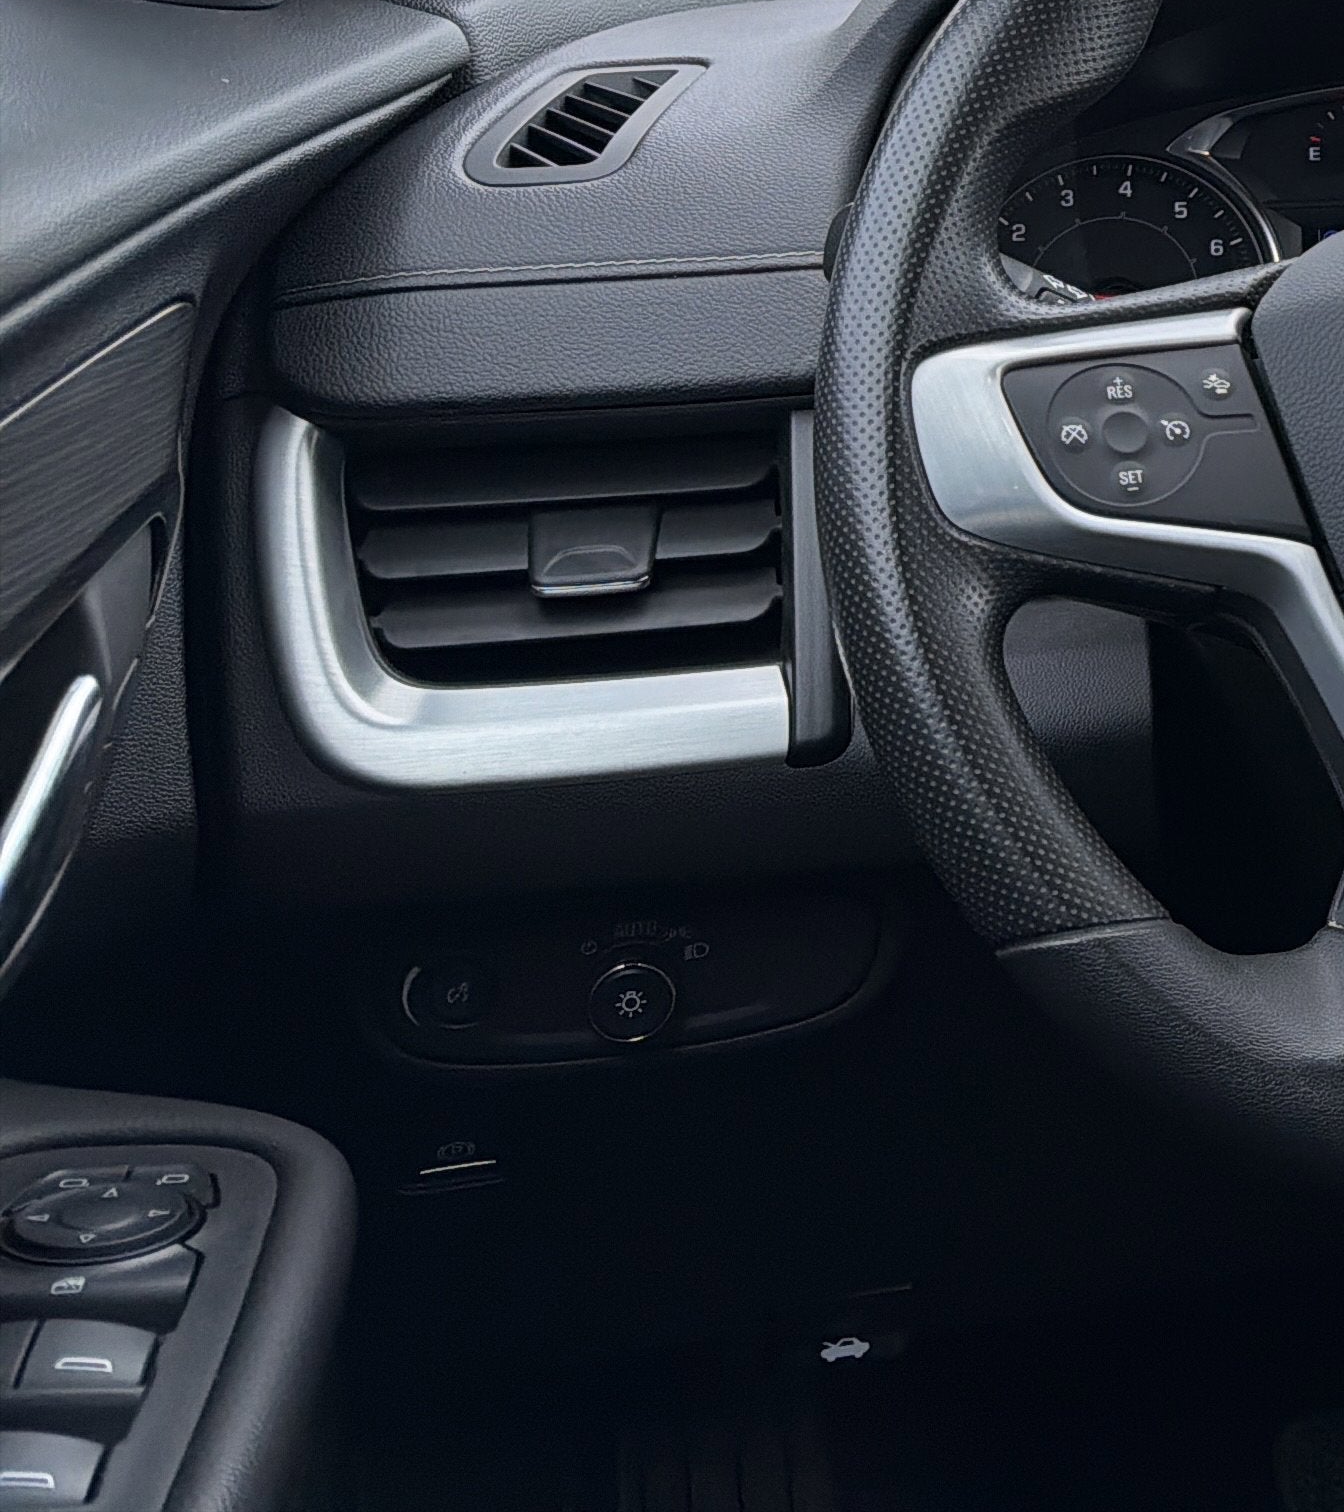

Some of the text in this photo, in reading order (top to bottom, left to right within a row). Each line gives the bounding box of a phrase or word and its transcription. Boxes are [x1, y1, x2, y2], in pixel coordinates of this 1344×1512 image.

[1308, 146, 1322, 162] E
[1060, 189, 1074, 207] 3
[1118, 180, 1133, 198] 4
[1174, 201, 1188, 219] 5
[1011, 223, 1026, 241] 2
[1210, 239, 1224, 257] 6
[1106, 384, 1133, 400] RES
[1118, 469, 1144, 486] SET
